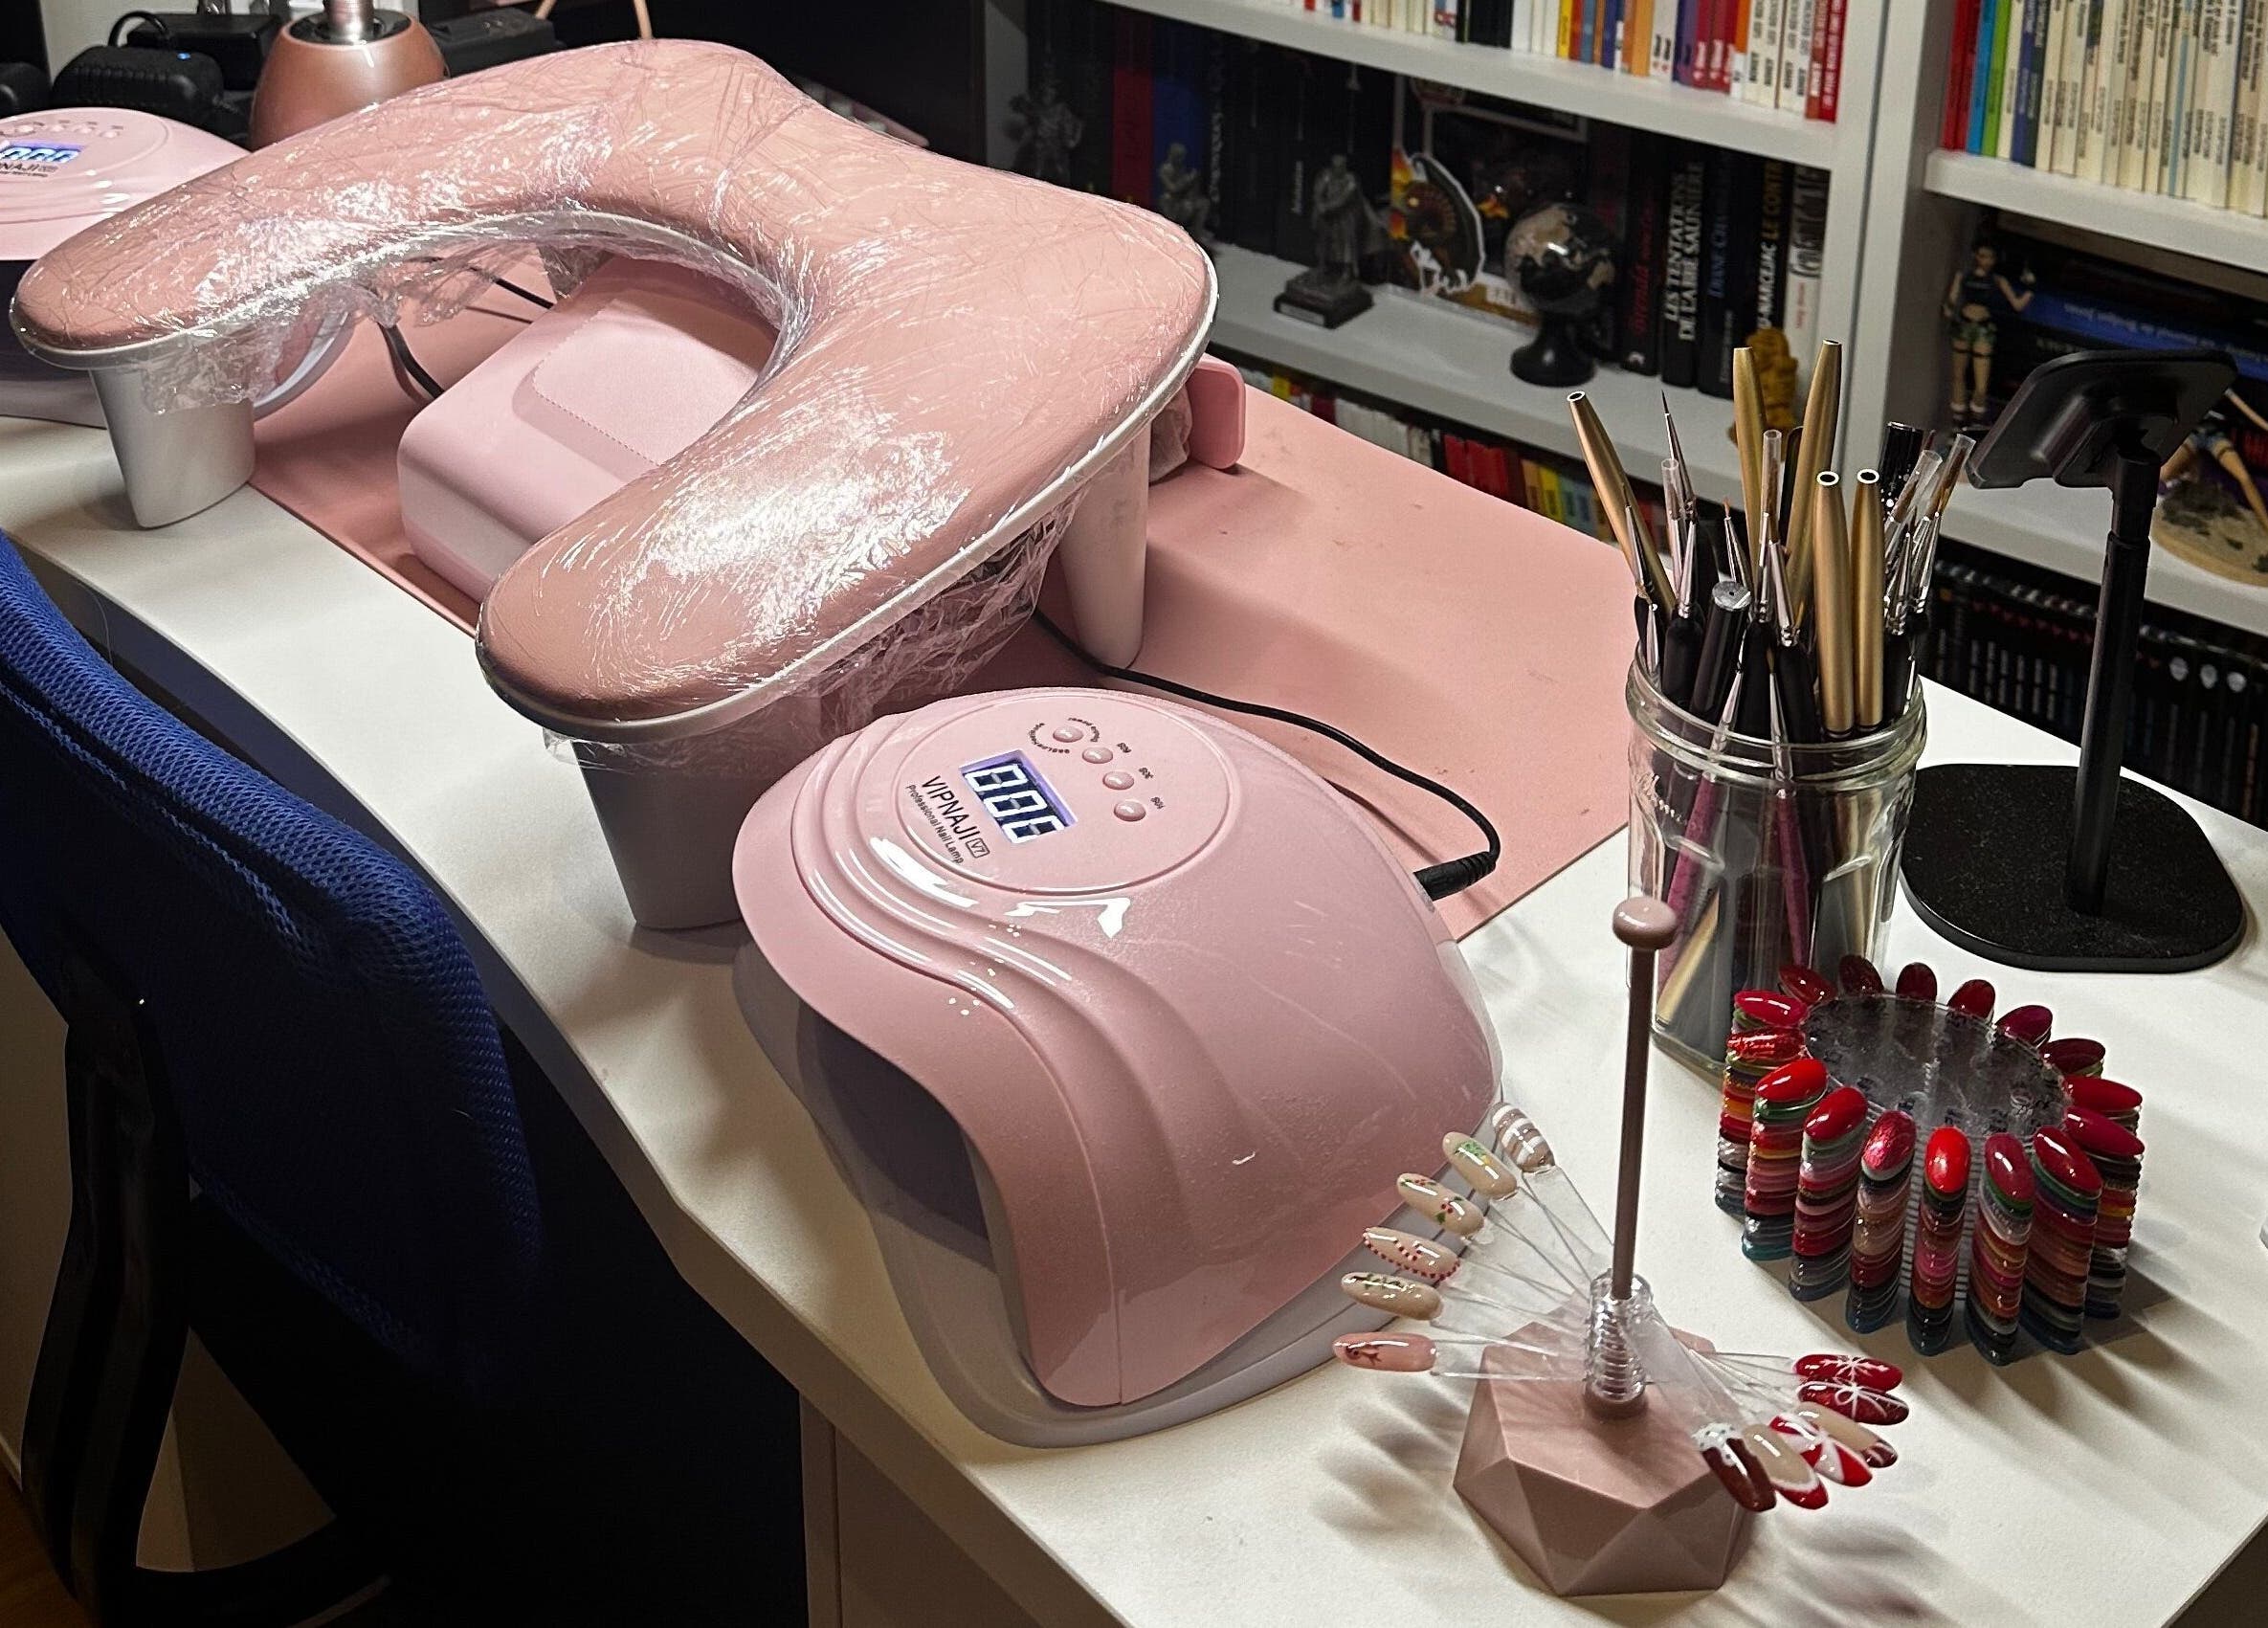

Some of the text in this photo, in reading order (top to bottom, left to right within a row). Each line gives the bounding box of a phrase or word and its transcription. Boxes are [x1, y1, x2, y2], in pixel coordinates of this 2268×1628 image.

[906, 785, 966, 865] Professional Nail Lamp
[922, 775, 981, 839] VIPNAJI
